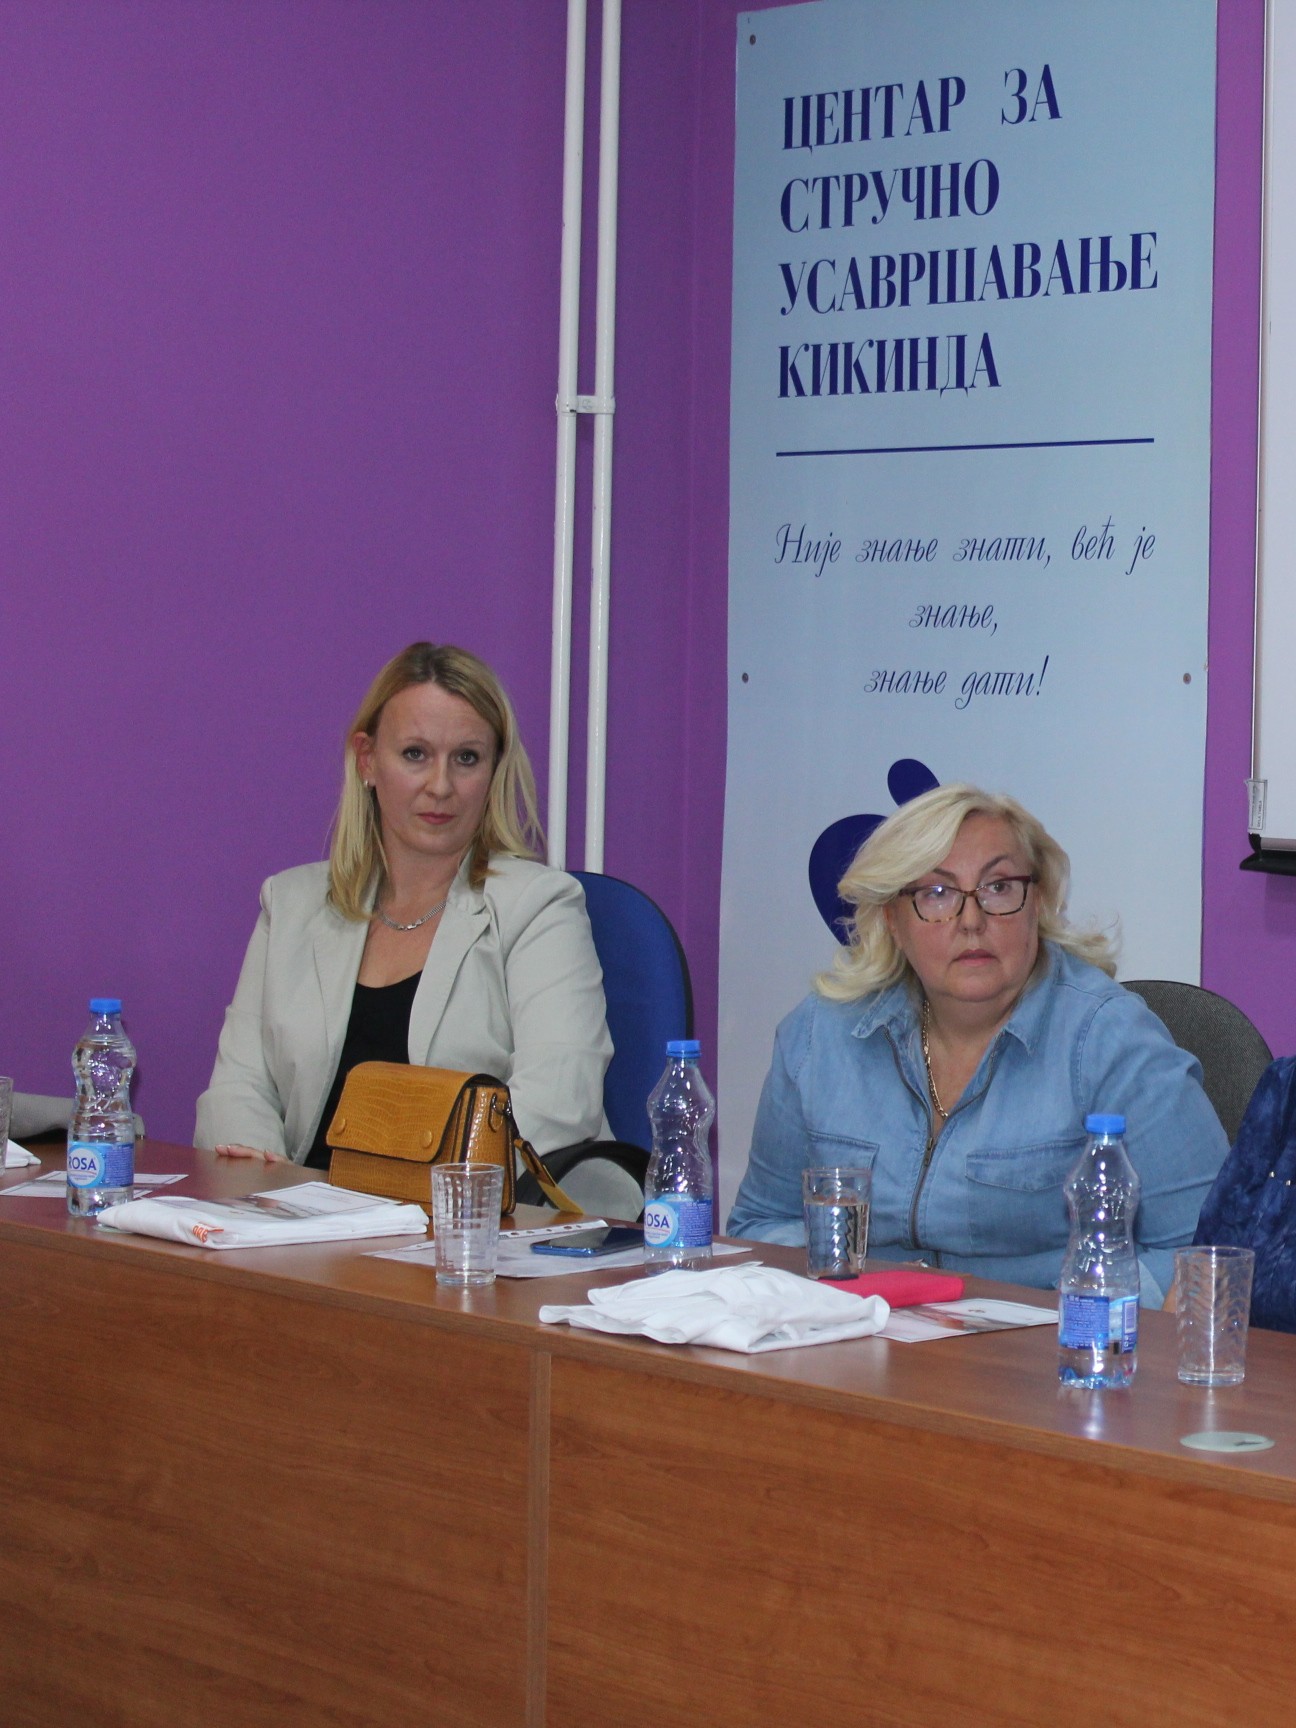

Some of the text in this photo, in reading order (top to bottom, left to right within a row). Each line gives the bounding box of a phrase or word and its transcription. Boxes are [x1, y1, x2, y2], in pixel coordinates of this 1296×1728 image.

[782, 64, 1062, 154] ЦЕНТАР ЗА
[780, 158, 1000, 233] СТРУЧНО
[778, 231, 1158, 316] УСАВРШАВАЊЕ
[777, 331, 1001, 399] КИКИНДА
[774, 515, 1156, 577] Није знање знати, већ је
[908, 603, 998, 636] знање,
[863, 655, 1049, 710] знање дати!
[645, 1213, 669, 1228] OSA
